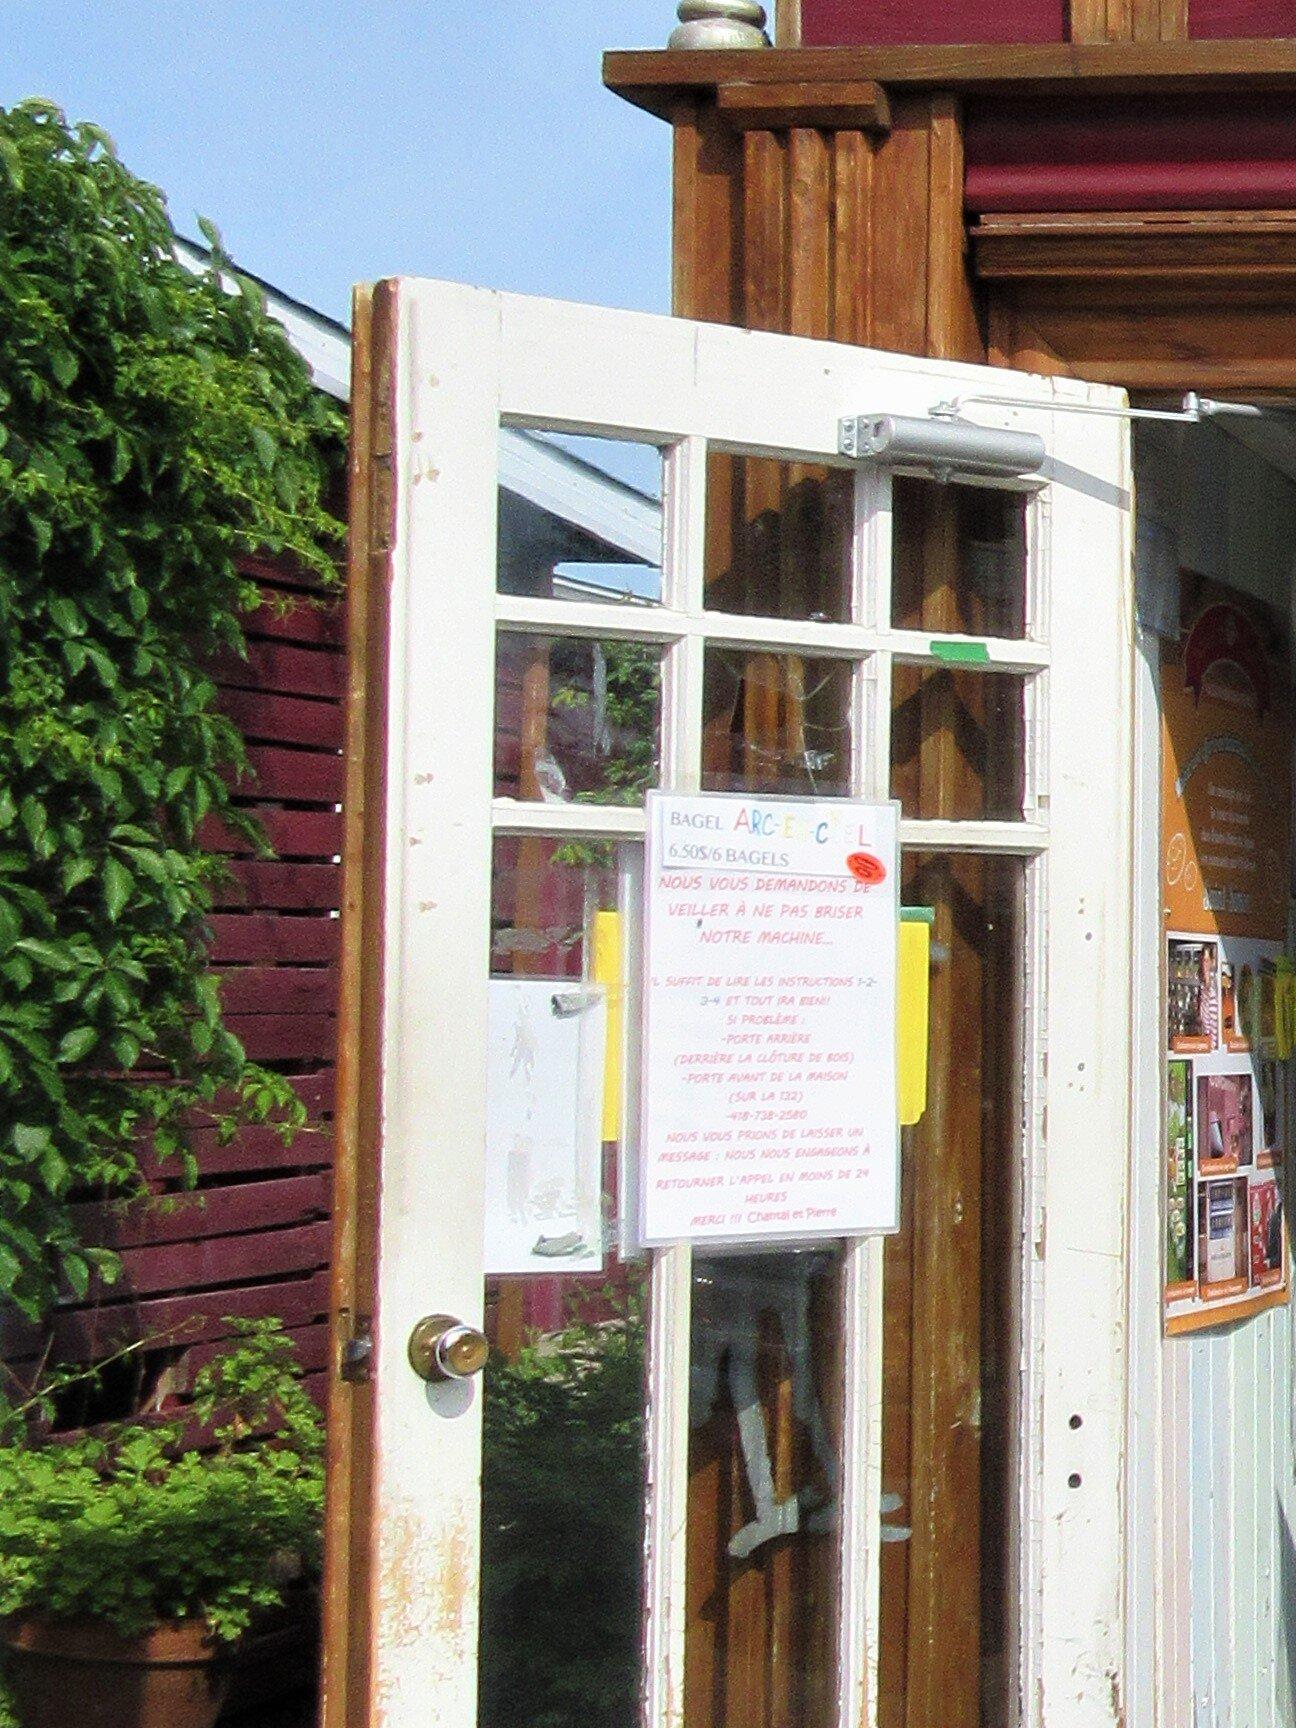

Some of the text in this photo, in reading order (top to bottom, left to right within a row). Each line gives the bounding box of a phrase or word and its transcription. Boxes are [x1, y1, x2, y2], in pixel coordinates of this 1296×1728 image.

[670, 810, 723, 831] BAGEL
[725, 847, 790, 868] BAGELS
[659, 874, 873, 894] NOUS VOUS DEMANDONS DE
[668, 900, 864, 920] VEILLER À NE PAS BRISER
[700, 929, 751, 945] NOTRE
